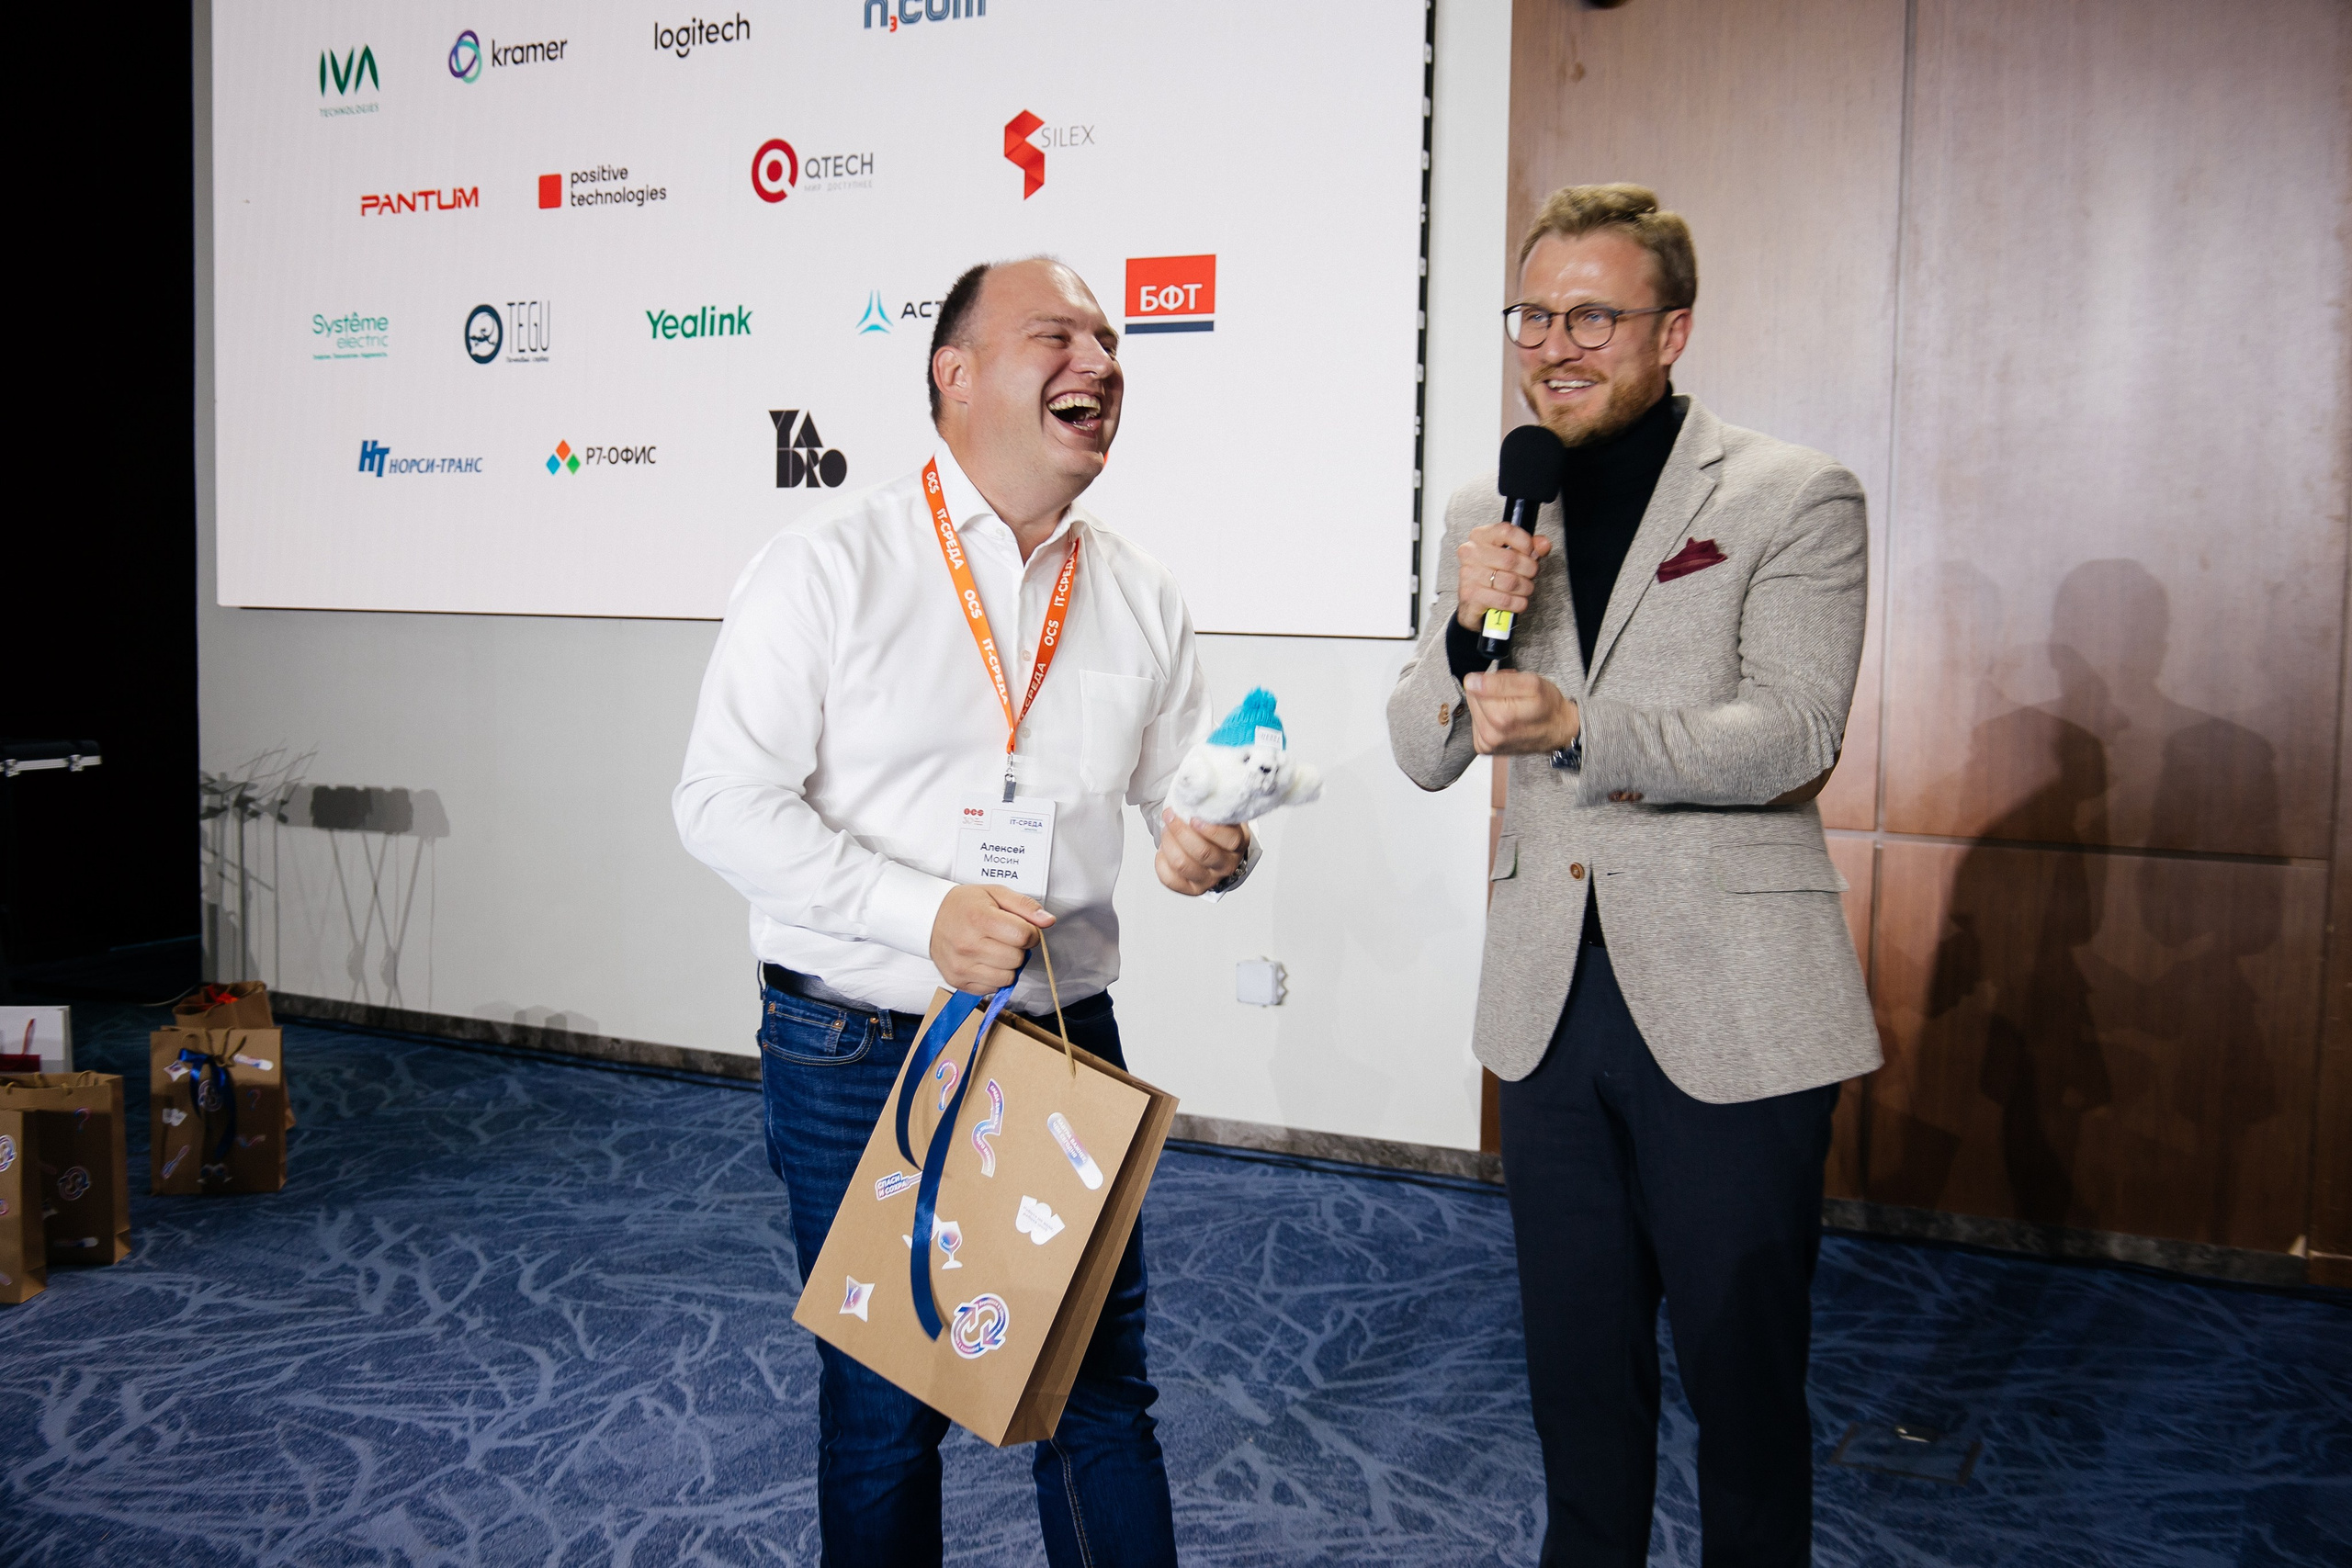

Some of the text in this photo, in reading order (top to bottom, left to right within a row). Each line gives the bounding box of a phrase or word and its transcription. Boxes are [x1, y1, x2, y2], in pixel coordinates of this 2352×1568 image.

[654, 13, 751, 58] logitech
[492, 38, 568, 68] kramer
[320, 44, 379, 97] IVA
[1041, 125, 1095, 148] SILEX
[571, 165, 628, 187] positive
[805, 152, 874, 179] QTECH
[361, 186, 479, 216] PANTUM
[571, 185, 666, 207] technologies
[1139, 283, 1203, 312] БФТ
[507, 300, 550, 353] TEGU
[645, 305, 752, 340] Yealink
[336, 332, 389, 349] electric
[389, 457, 483, 473] НОРСИ-ТРАНС
[586, 446, 657, 465] Р7-ОФИС
[926, 471, 940, 494] OCS
[964, 589, 982, 619] OCS
[1044, 619, 1059, 647] OCS
[964, 808, 984, 817] OCS
[980, 842, 1024, 854] Алексей
[984, 854, 1019, 864] Мосин
[981, 868, 1018, 879] NERPA
